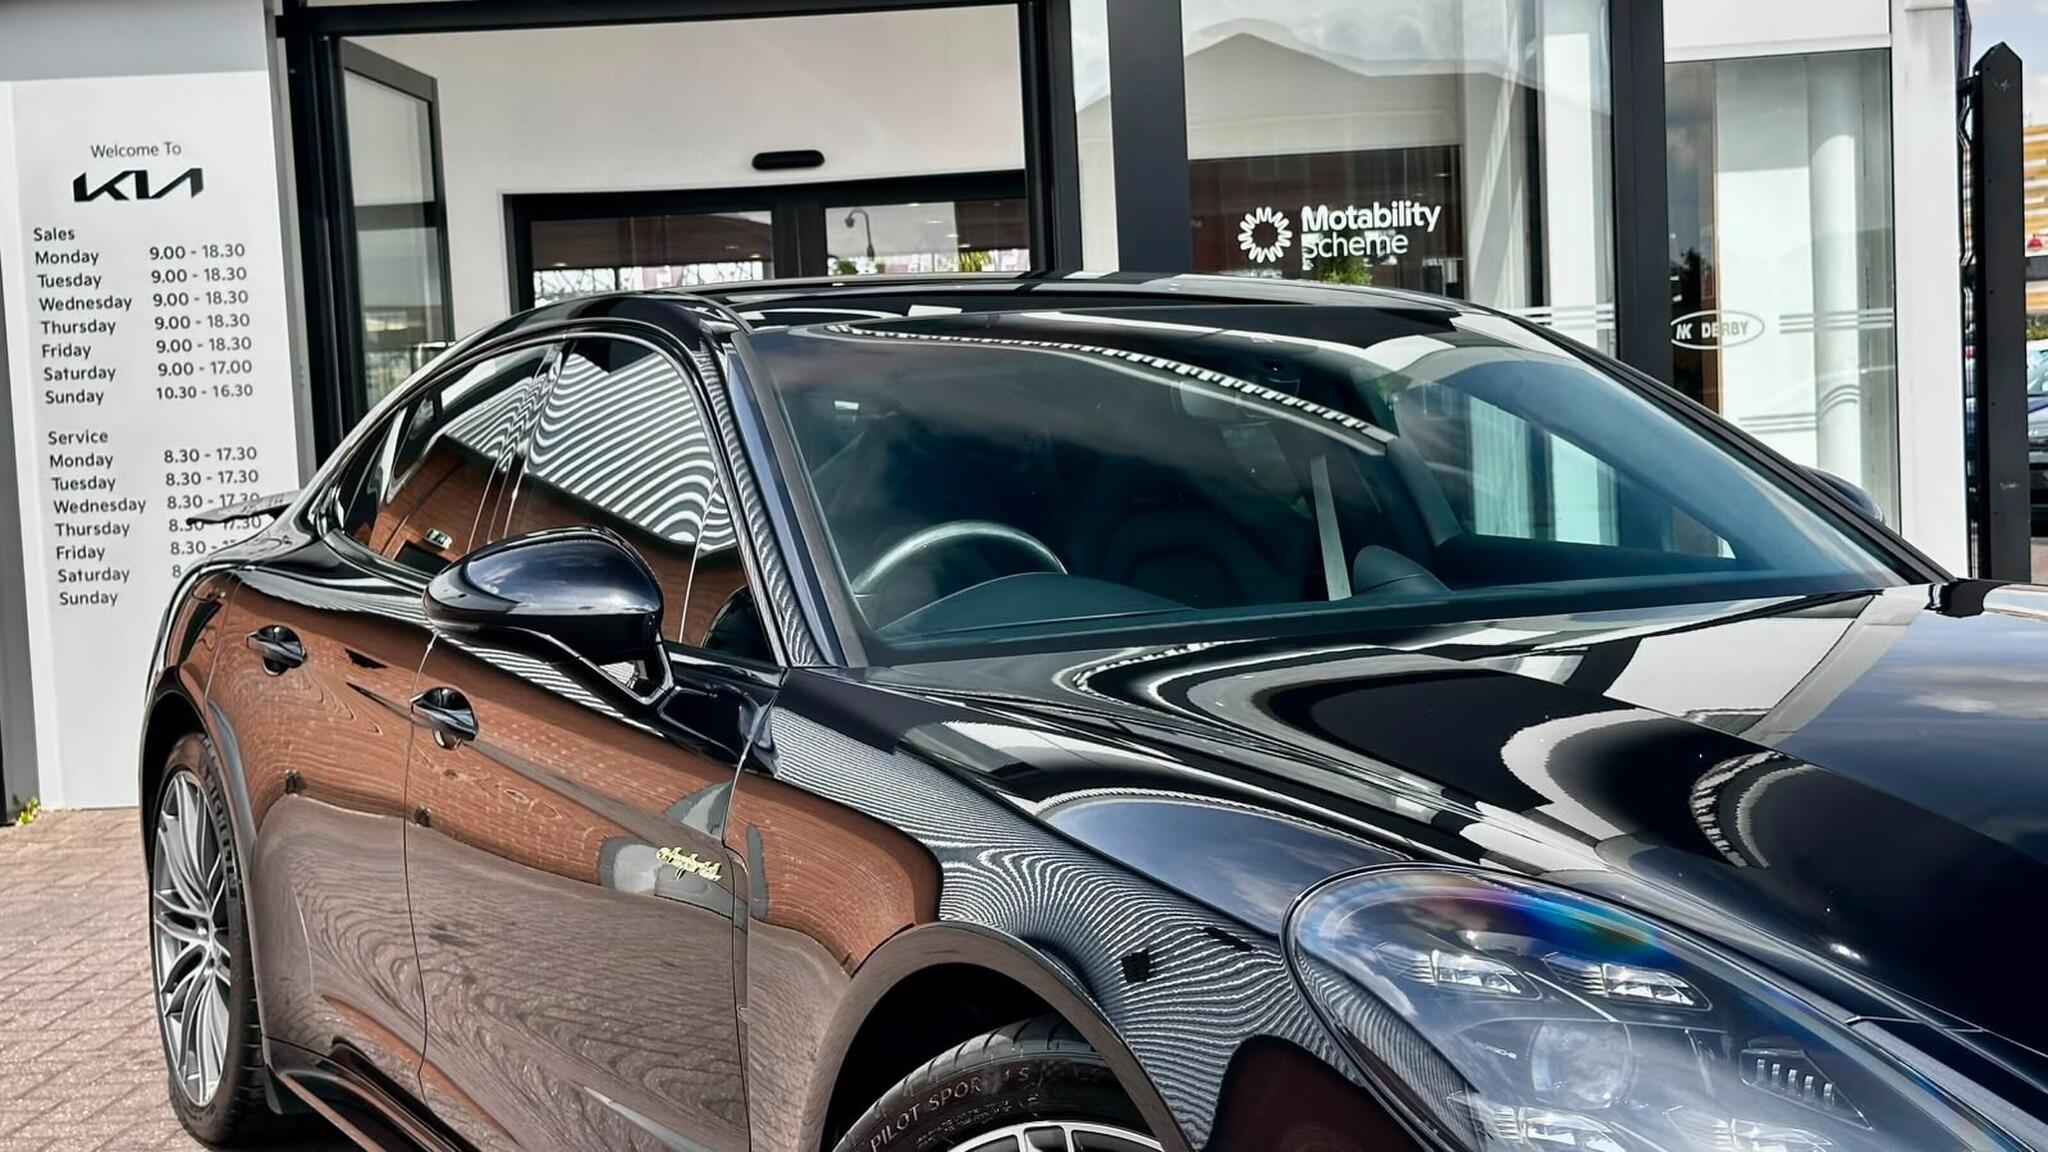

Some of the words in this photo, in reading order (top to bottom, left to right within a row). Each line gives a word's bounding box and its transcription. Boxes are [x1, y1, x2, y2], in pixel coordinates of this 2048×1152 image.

[90, 144, 160, 159] Welcome
[163, 141, 182, 156] To
[72, 167, 204, 203] KIA
[1301, 200, 1442, 232] Motability
[33, 227, 76, 243] Sales
[1302, 231, 1409, 259] Scheme
[35, 249, 100, 267] Monday
[149, 246, 187, 261] 9.00
[202, 243, 246, 259] 18.30
[36, 273, 102, 290] Tuesday
[151, 269, 188, 284] 9.00
[204, 266, 247, 283] 18.30
[38, 295, 133, 312] Wednesday
[153, 292, 189, 307] 9.00
[206, 289, 249, 305] 18.30
[40, 319, 117, 336] Thursday
[154, 315, 191, 331] 9.00
[207, 312, 251, 329] 18.30
[1701, 320, 1749, 339] DERBY
[42, 343, 92, 360] Friday
[156, 338, 193, 354] 9.00
[209, 335, 252, 352] 18.30
[44, 365, 117, 382] Saturday
[158, 362, 194, 377] 9.00
[210, 359, 253, 375] 17.00
[45, 389, 105, 406] Sunday
[156, 386, 197, 400] 10.30
[212, 383, 254, 398] 16.30
[48, 429, 109, 446] Service
[49, 452, 114, 470] Monday
[164, 448, 200, 464] 8.30
[216, 446, 258, 461] 17.30
[52, 476, 116, 493] Tuesday
[165, 471, 202, 487] 8.30
[218, 468, 259, 484] 17.30
[53, 497, 147, 514] Wednesday
[167, 494, 203, 510] 8.30
[54, 521, 131, 538] Thursday
[56, 544, 106, 562] Friday
[170, 540, 206, 556] 8.30
[58, 567, 131, 584] Saturday
[59, 590, 119, 607] Sunday
[870, 1102, 921, 1152] PILOT
